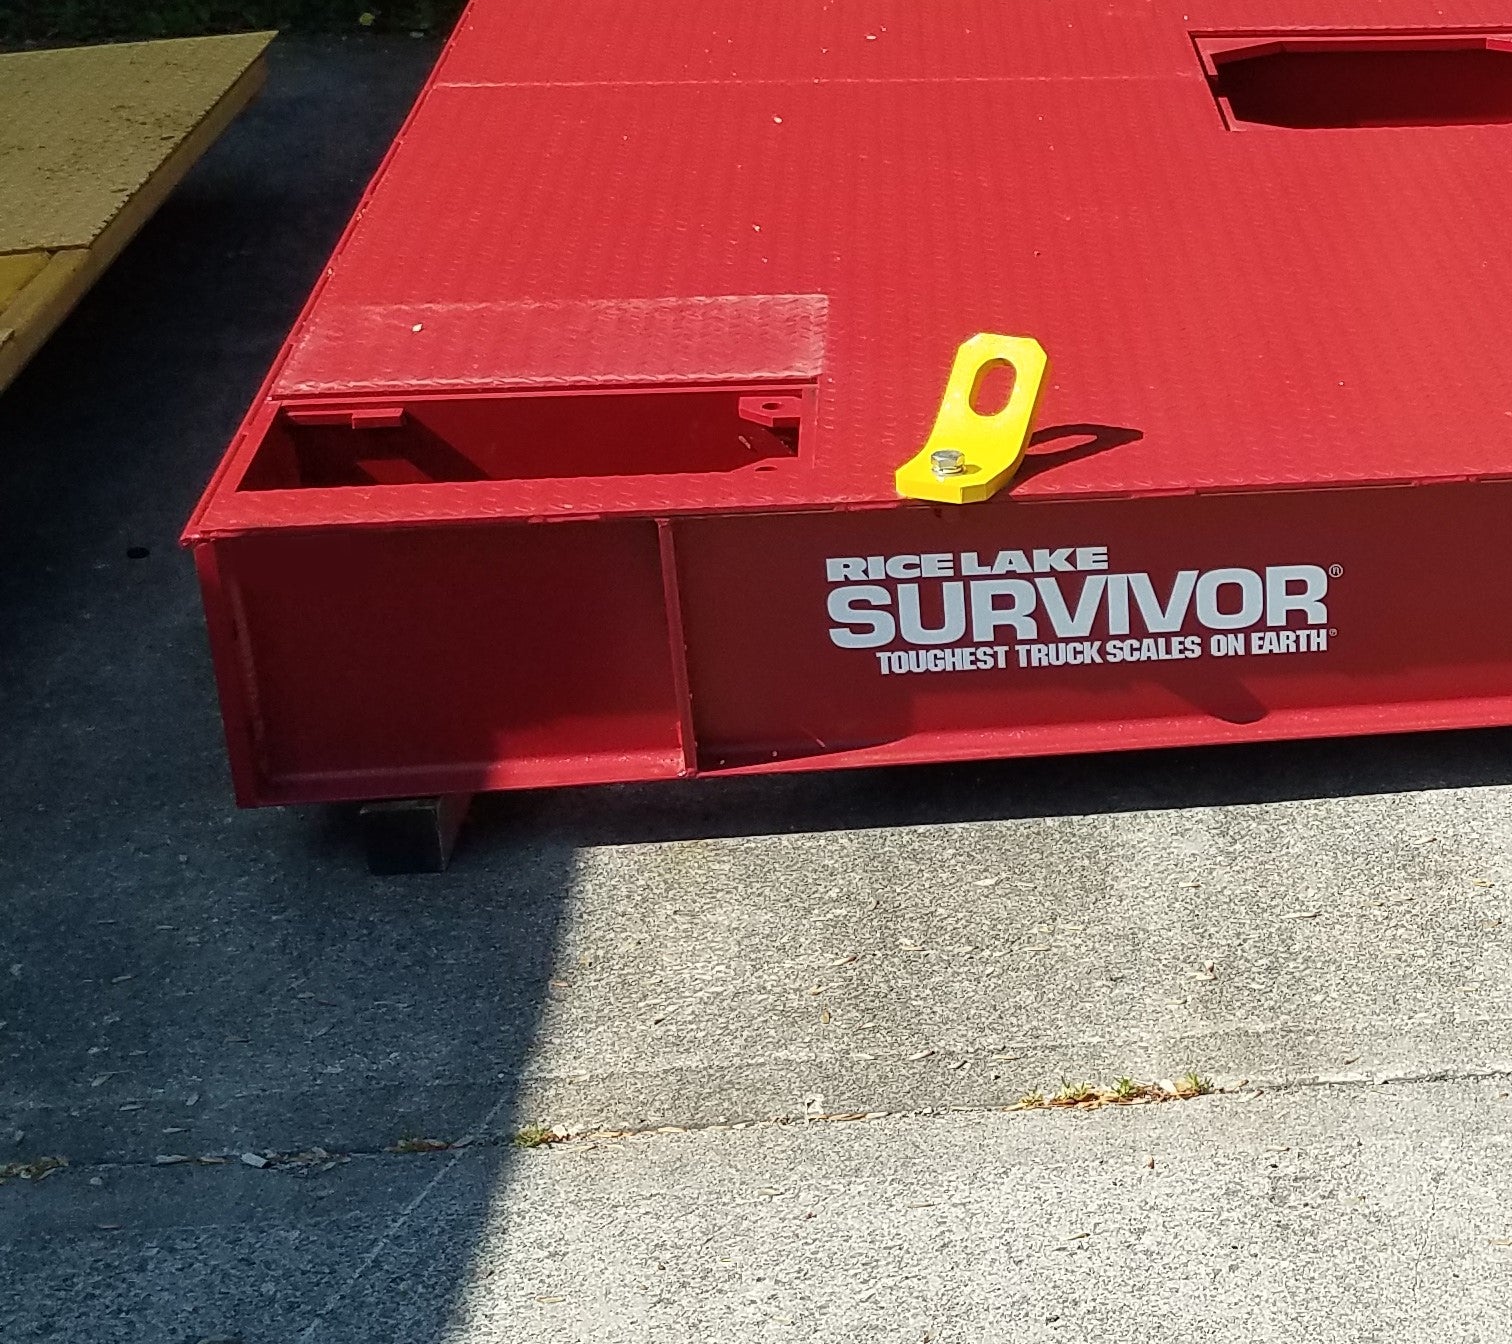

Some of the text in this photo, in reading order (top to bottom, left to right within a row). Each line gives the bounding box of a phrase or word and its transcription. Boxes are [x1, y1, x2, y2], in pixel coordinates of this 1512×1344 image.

[826, 546, 1108, 582] RICE LAKE
[876, 629, 1328, 675] TOUGHEST TRUCK SCALES ON EARTH
